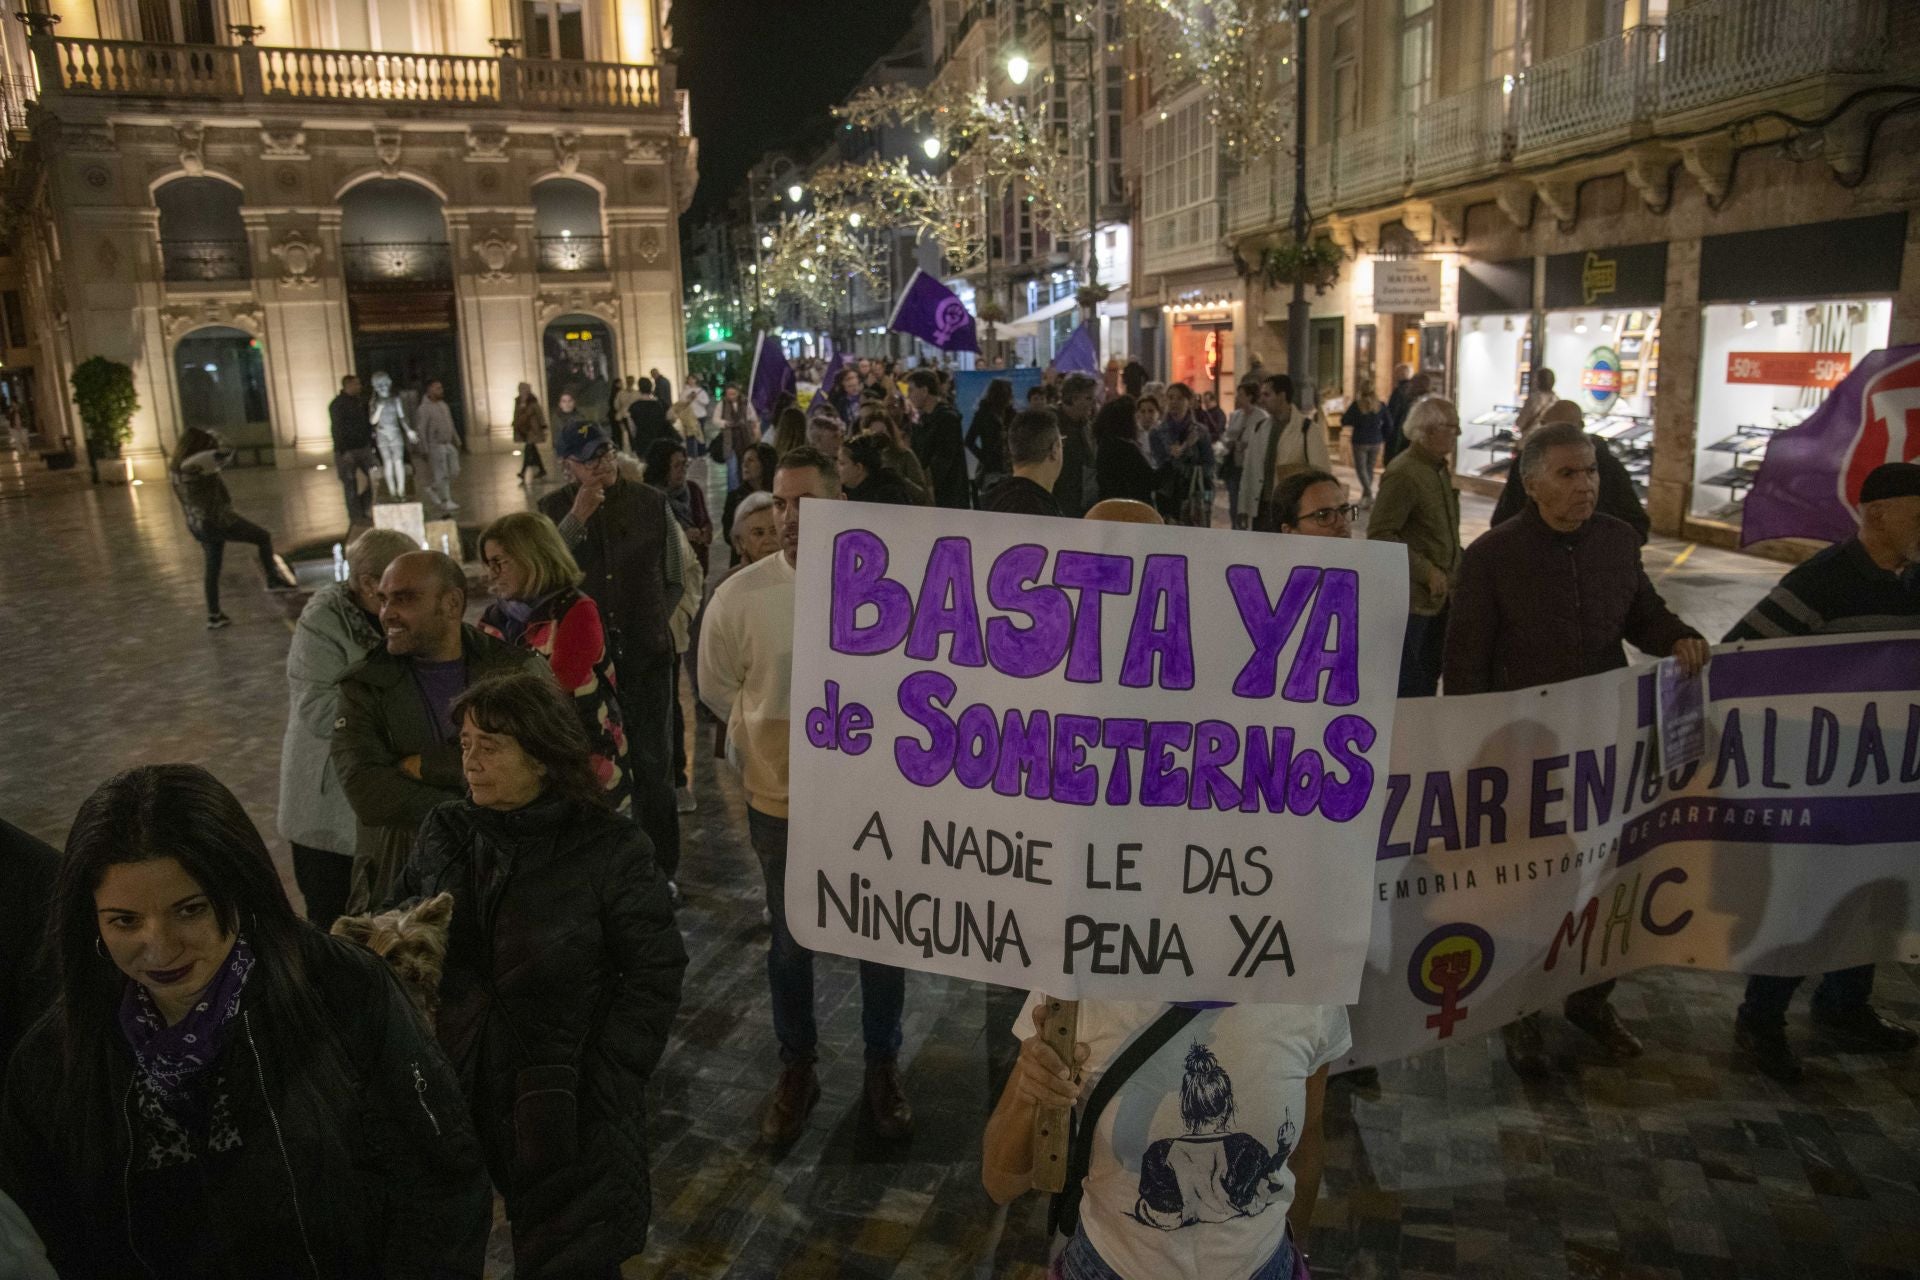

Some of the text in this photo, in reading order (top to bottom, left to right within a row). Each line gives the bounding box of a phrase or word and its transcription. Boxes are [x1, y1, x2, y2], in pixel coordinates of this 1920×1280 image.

[1729, 357, 1761, 378] -50%
[1809, 359, 1847, 382] -50%
[829, 528, 1360, 708] BASTA YA
[805, 680, 875, 757] de
[1530, 744, 1616, 838] EN
[1658, 806, 1812, 828] CARTAGENA
[852, 811, 893, 861] A
[1086, 843, 1143, 892] LE
[1182, 845, 1273, 897] DAS
[1062, 914, 1195, 977] PENA
[1227, 914, 1296, 979] YA
